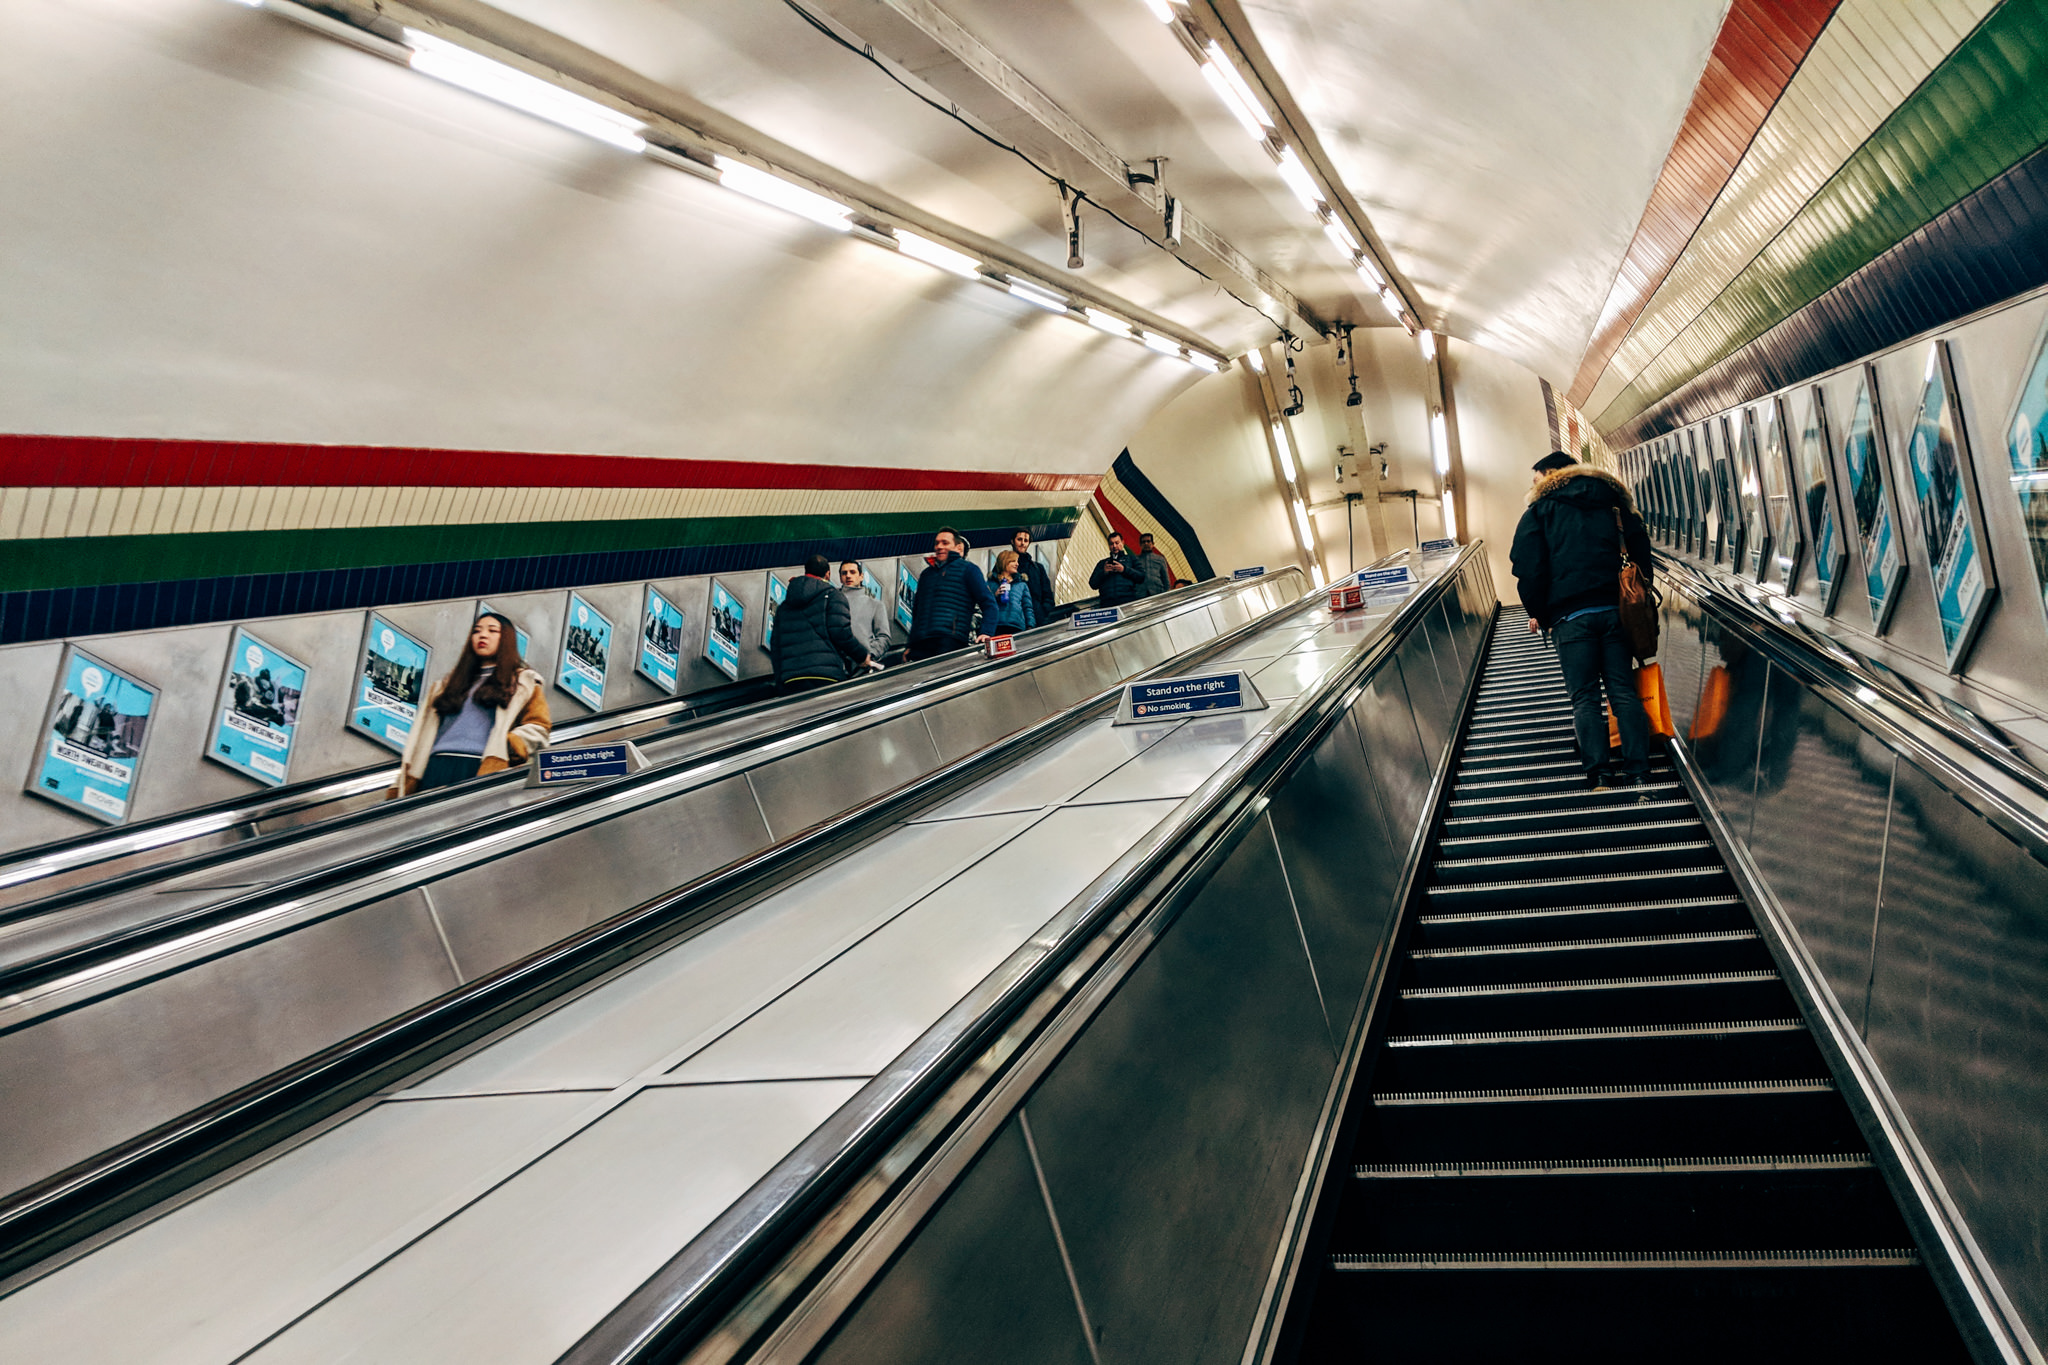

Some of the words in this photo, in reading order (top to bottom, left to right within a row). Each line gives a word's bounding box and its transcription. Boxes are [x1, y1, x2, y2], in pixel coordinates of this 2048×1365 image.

[1146, 686, 1172, 697] Stand
[1186, 683, 1202, 692] the
[1203, 680, 1226, 691] right
[1159, 702, 1191, 711] smoking
[551, 754, 572, 763] Stand
[583, 752, 597, 760] the
[597, 750, 615, 760] right
[561, 769, 588, 777] smoking
